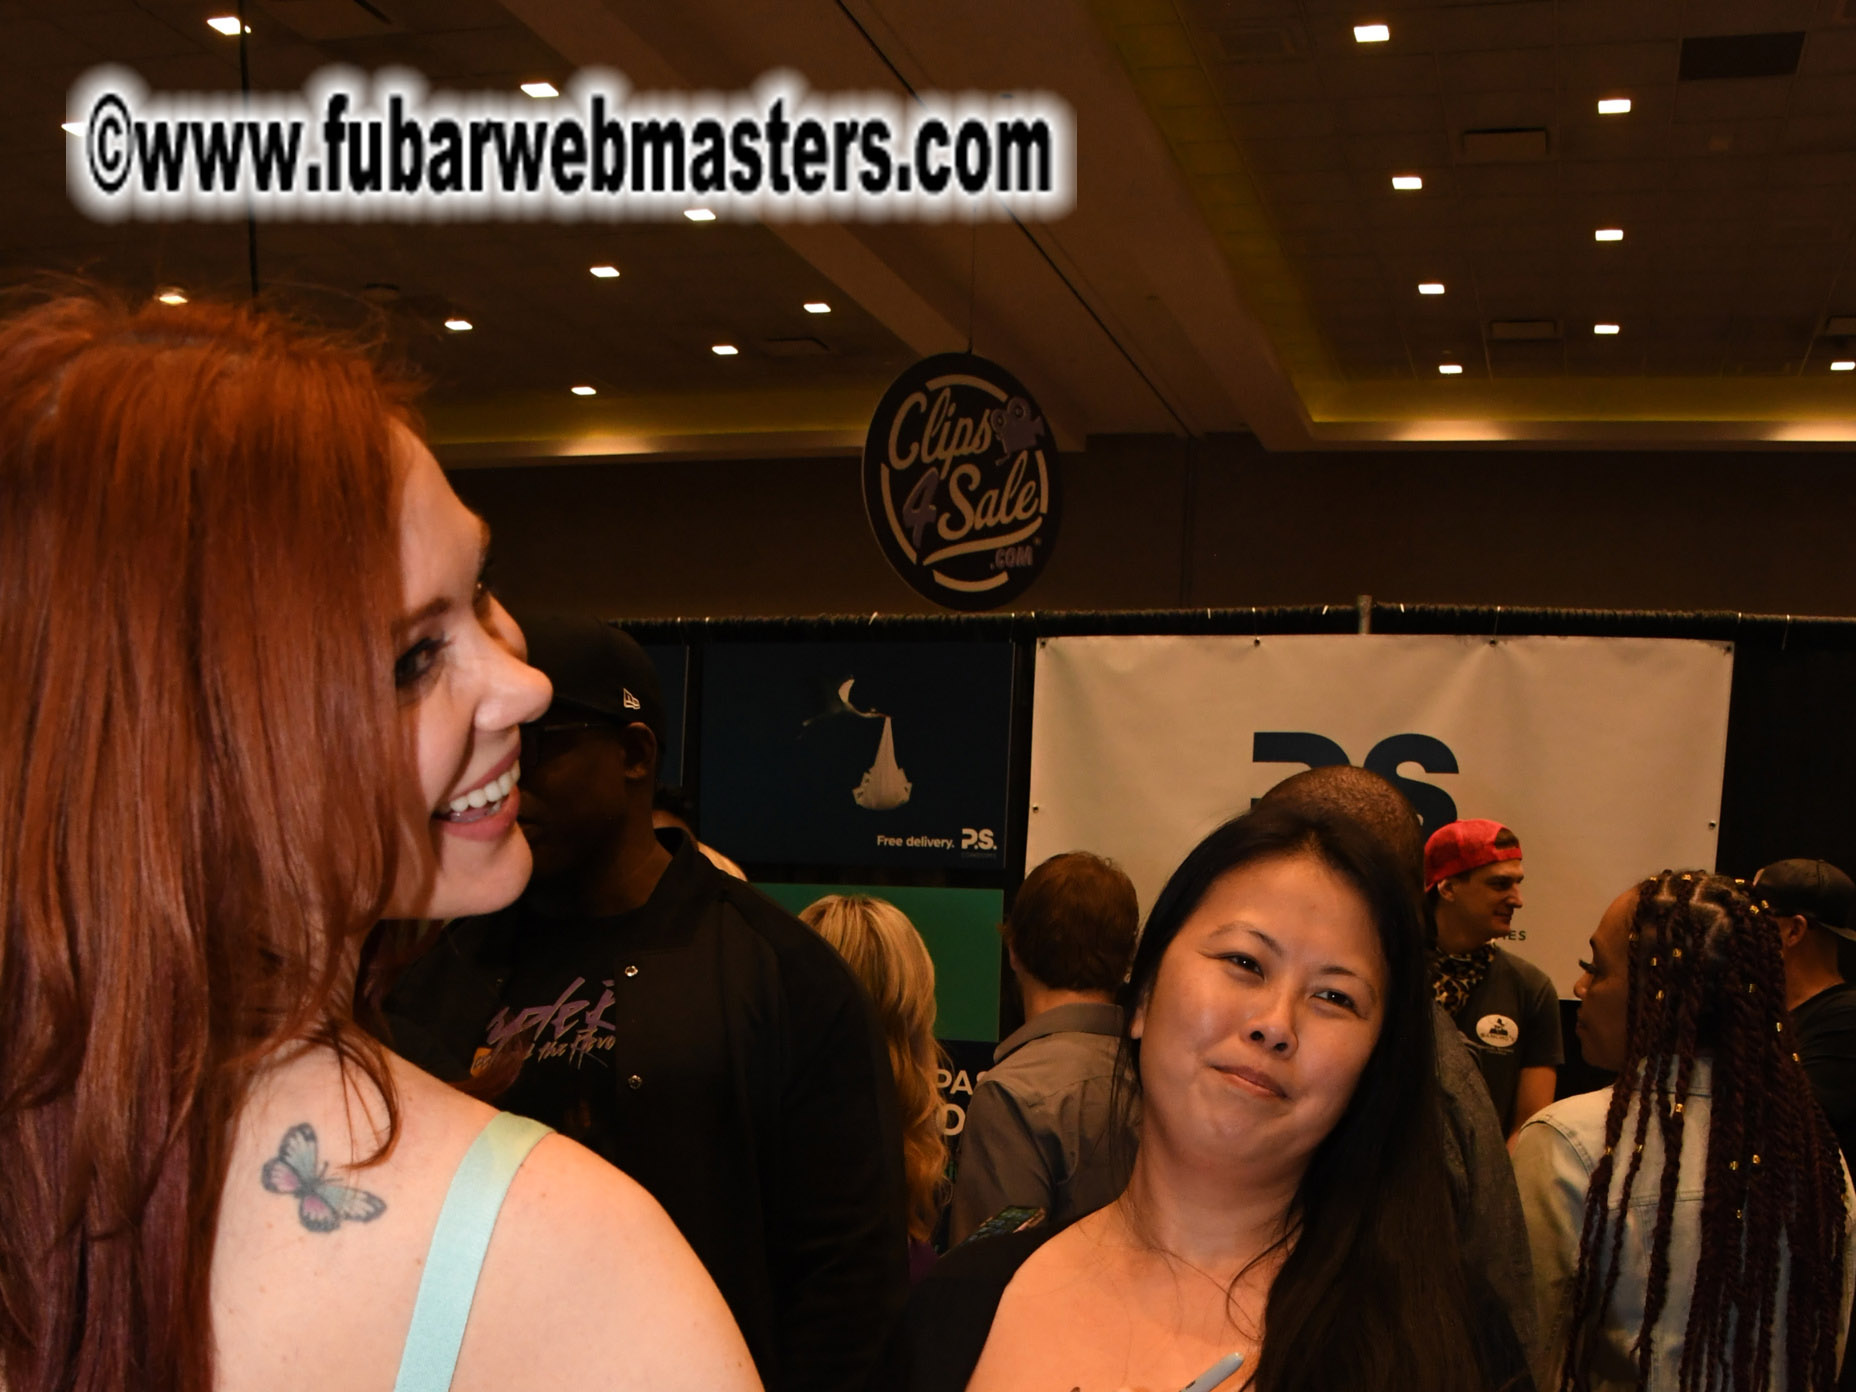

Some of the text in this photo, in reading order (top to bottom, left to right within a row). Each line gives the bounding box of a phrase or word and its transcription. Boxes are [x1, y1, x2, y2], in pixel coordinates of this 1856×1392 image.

[888, 387, 993, 480] Clips
[903, 450, 1040, 549] 4 Sale
[877, 835, 903, 846] Free
[906, 836, 955, 850] delivery.
